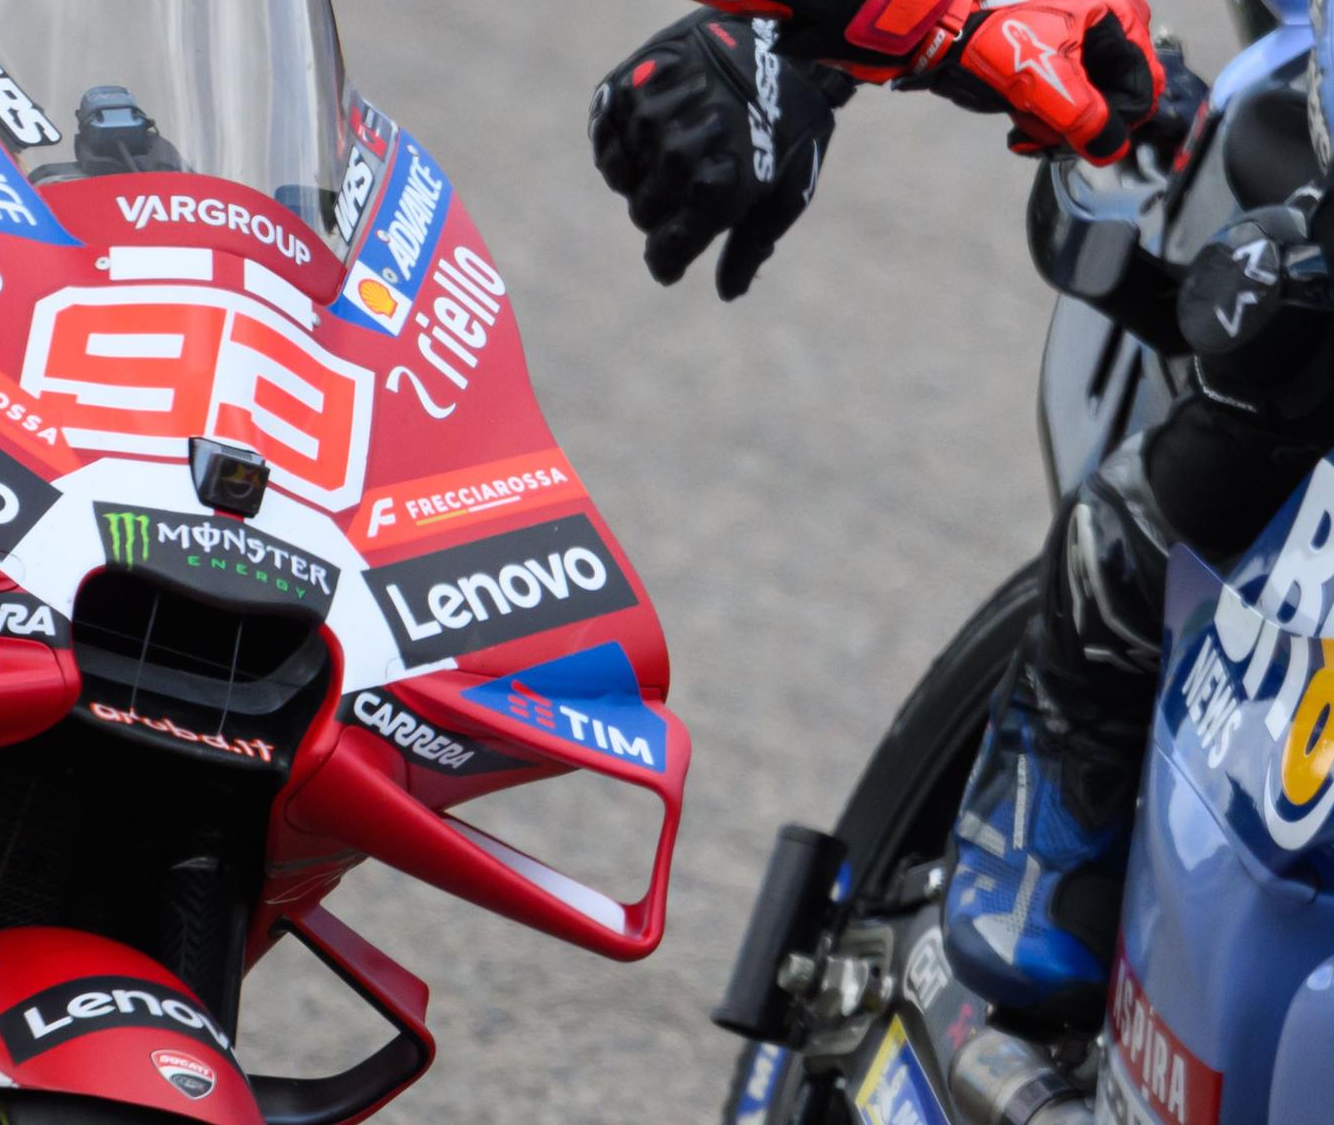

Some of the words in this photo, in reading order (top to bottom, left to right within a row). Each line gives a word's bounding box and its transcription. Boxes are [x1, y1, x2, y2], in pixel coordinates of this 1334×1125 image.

[115, 195, 312, 267] VARGROUP
[385, 149, 444, 281] ADVANCE
[19, 285, 376, 513] 93
[405, 466, 567, 520] FRECCIAROSSA
[157, 522, 332, 596] MONSTER
[187, 555, 307, 600] ENERGY
[385, 546, 607, 642] Lenovo
[89, 700, 276, 765] aruba.it
[353, 692, 476, 771] CARRERA
[560, 706, 655, 766] TIM
[1182, 635, 1242, 769] NEWS
[23, 988, 235, 1052] Lenov
[1113, 958, 1186, 1124] ASPIRA
